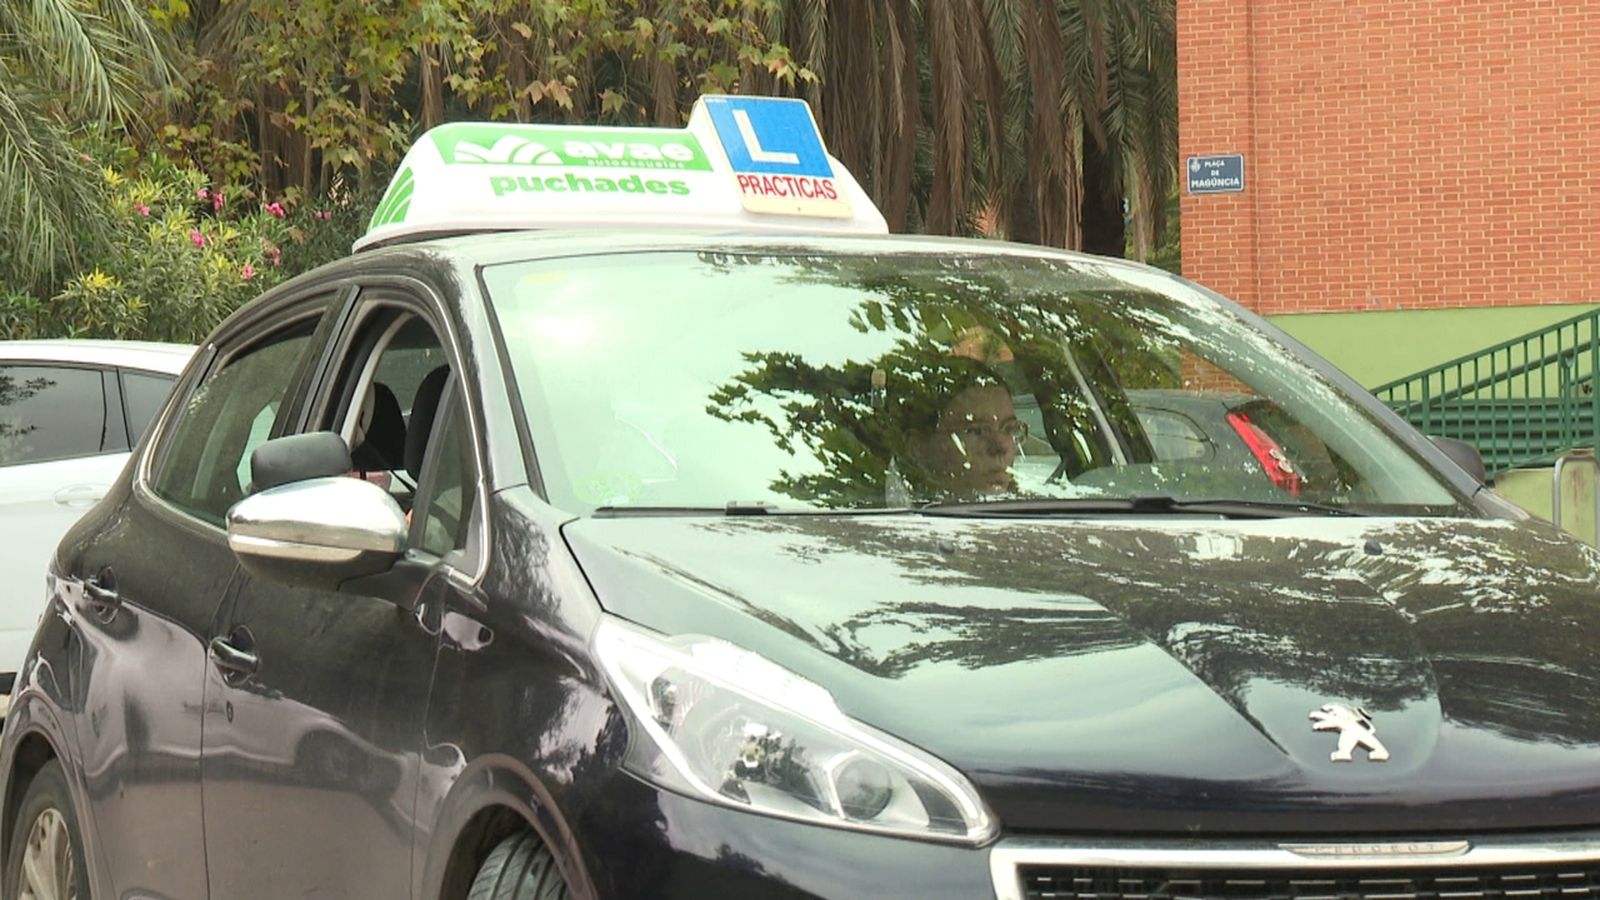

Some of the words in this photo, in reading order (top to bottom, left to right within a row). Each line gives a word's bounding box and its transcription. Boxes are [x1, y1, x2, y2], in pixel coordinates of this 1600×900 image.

[732, 109, 800, 164] L
[1204, 160, 1225, 168] PLAÇA
[489, 173, 690, 197] puchades
[736, 174, 838, 200] PRACTICAS
[1191, 177, 1240, 188] MAGÚNCIA
